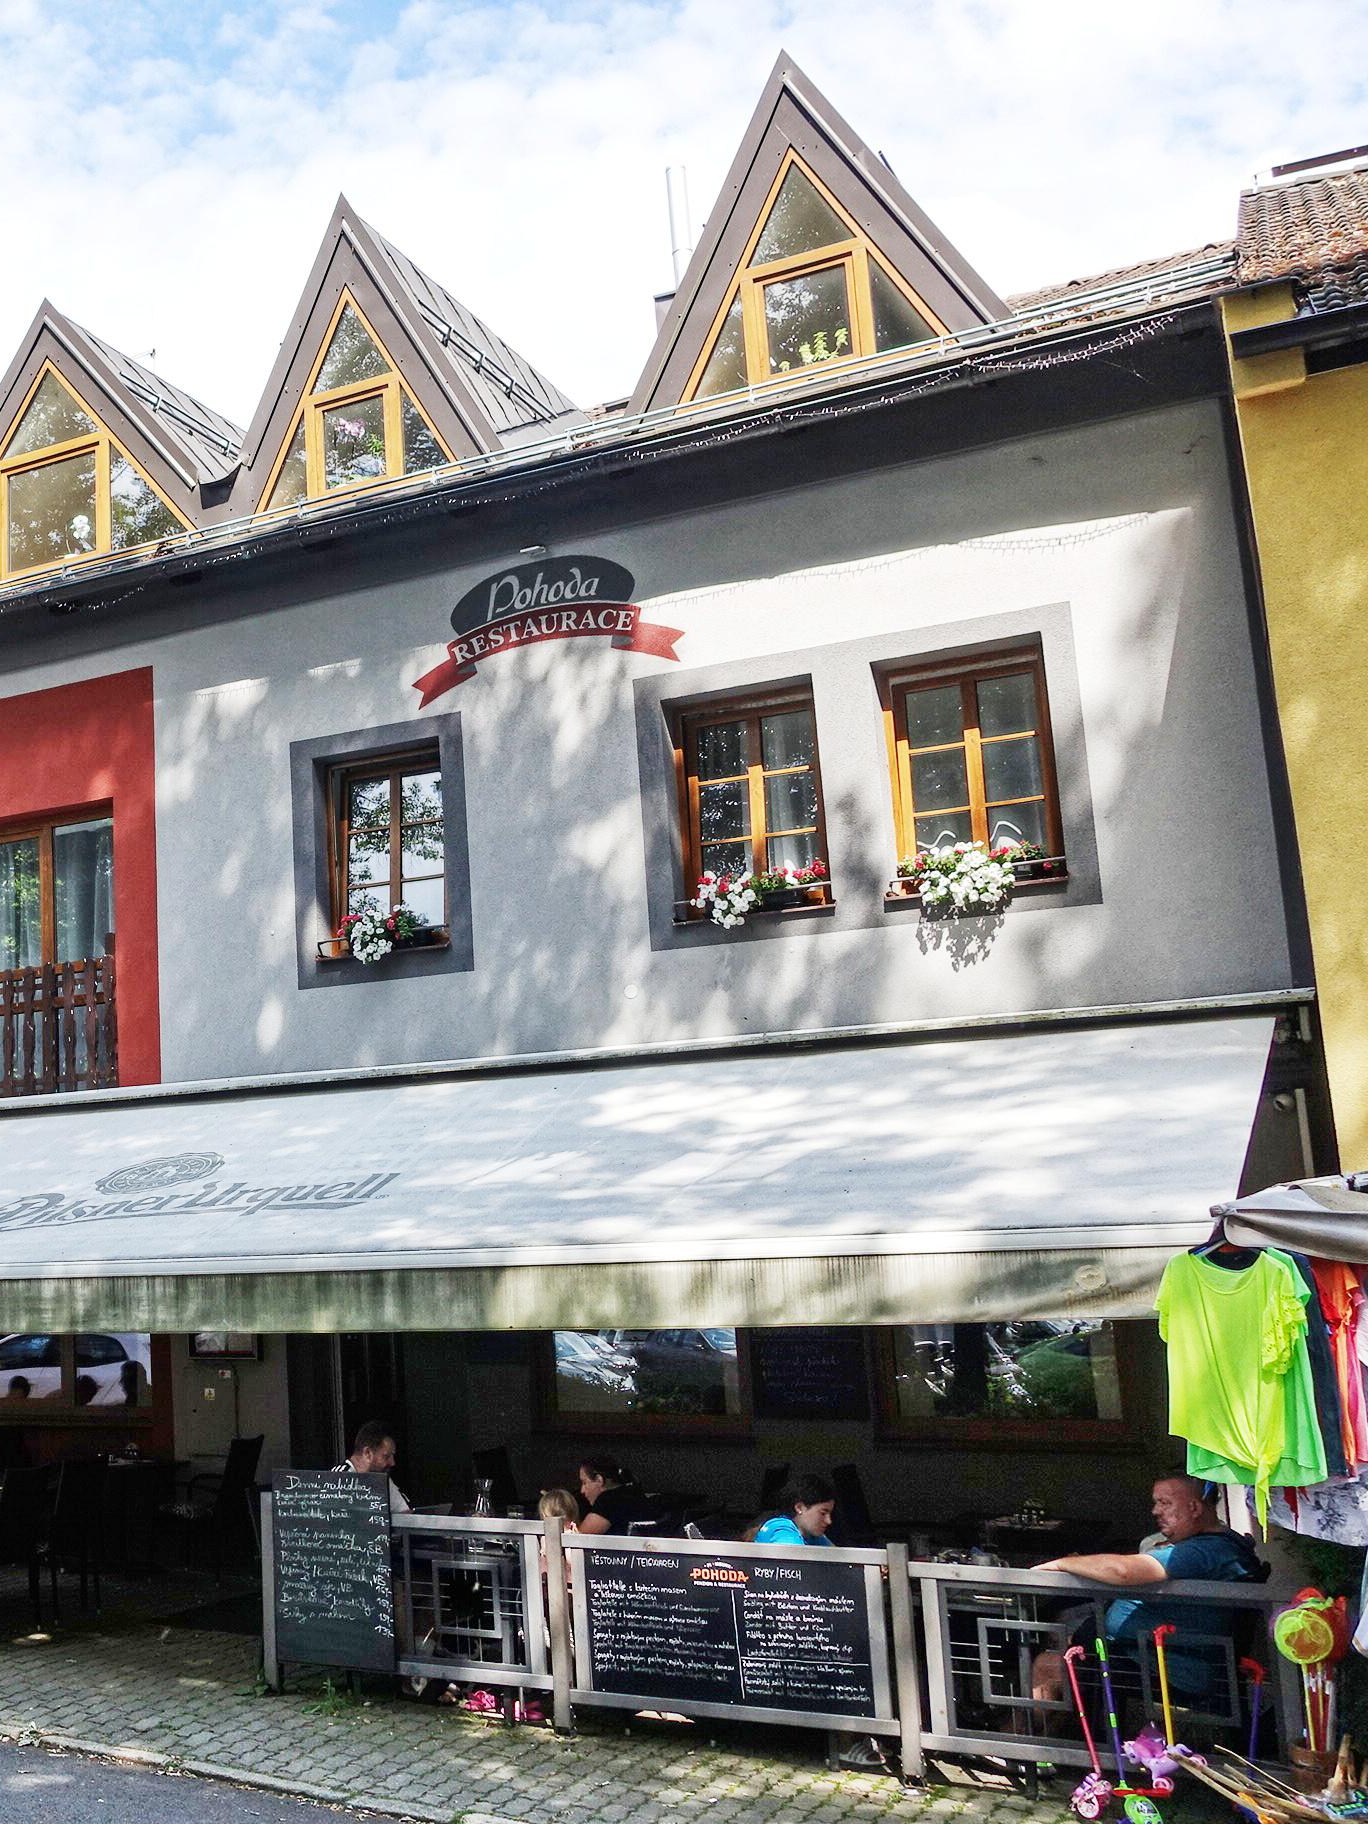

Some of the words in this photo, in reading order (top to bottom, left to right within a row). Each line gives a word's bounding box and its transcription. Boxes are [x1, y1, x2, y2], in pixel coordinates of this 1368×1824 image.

[175, 1172, 401, 1216] Urquell
[487, 1568, 600, 1622] Pohoda
[690, 1567, 750, 1584] POHODA
[452, 1609, 634, 1665] RESTAURACE
